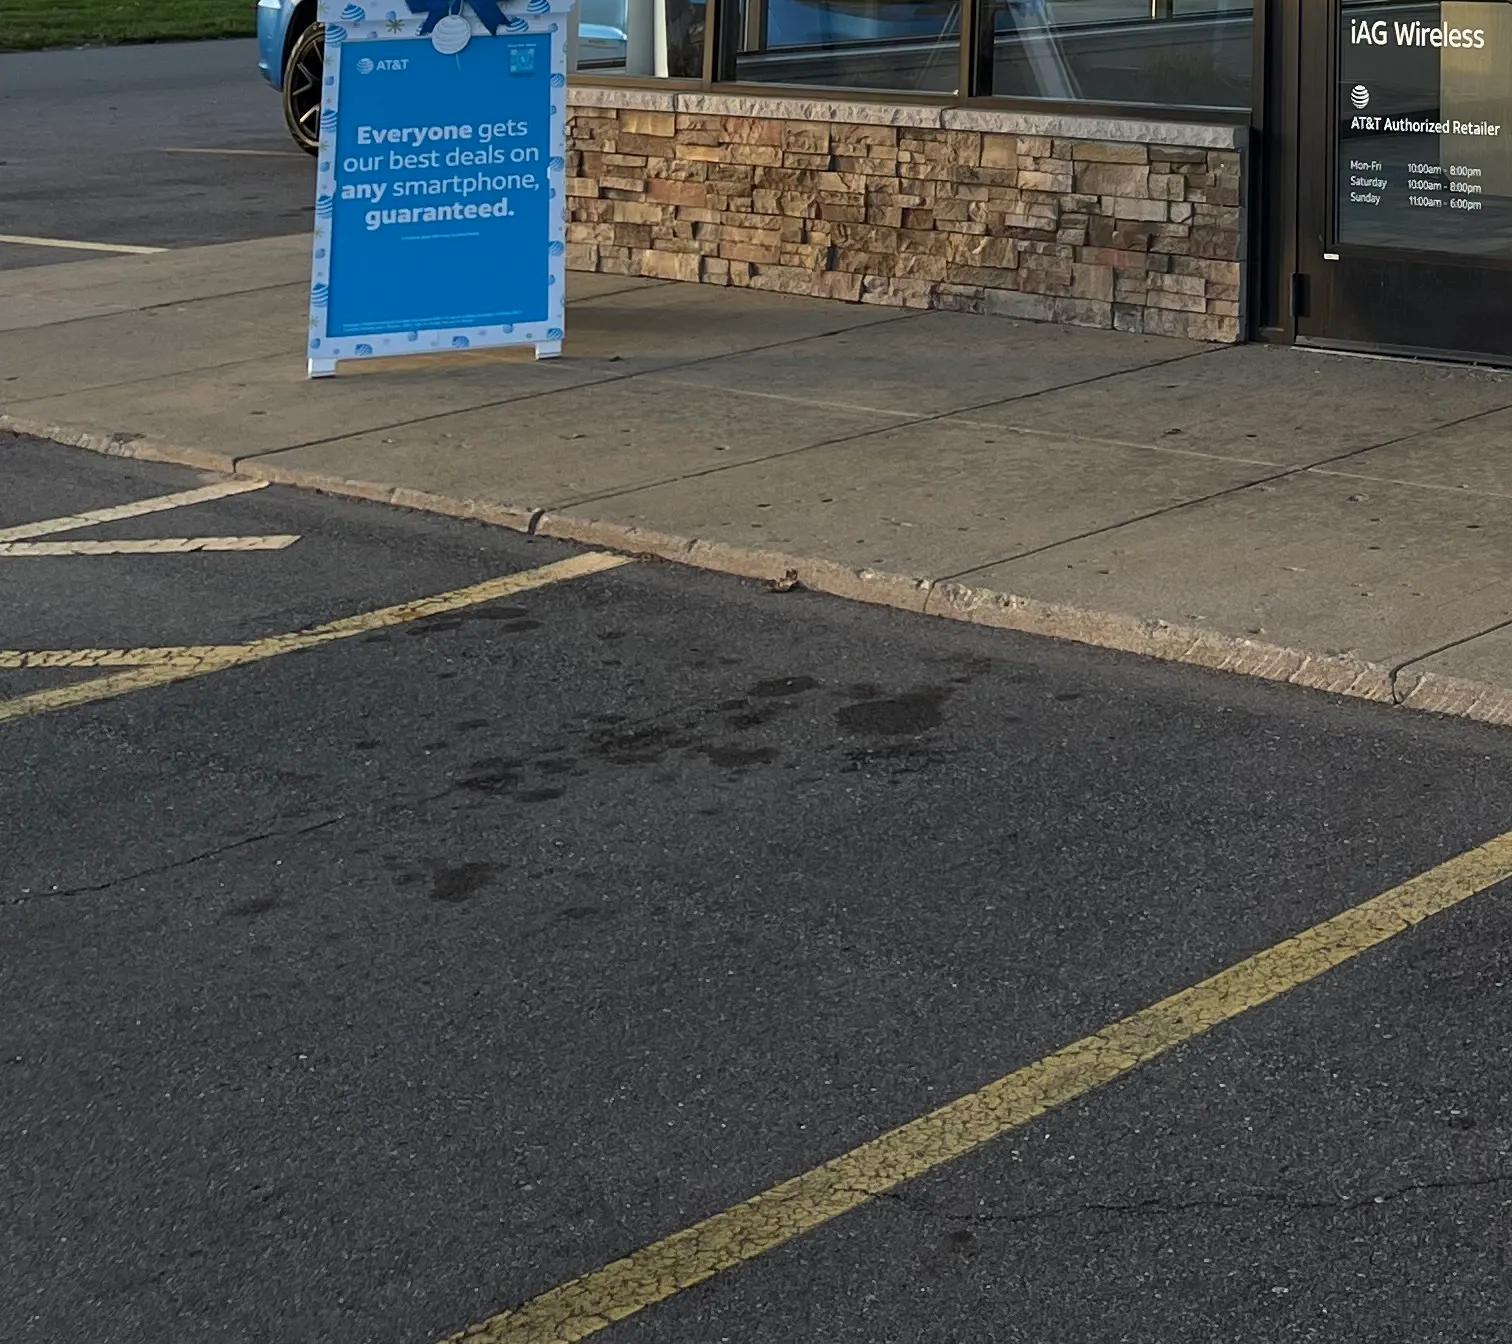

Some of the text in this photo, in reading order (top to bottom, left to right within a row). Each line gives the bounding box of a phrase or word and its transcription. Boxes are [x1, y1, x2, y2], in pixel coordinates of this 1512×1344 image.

[1351, 18, 1485, 49] iAG Wireless
[375, 59, 409, 71] AT&T
[357, 119, 528, 147] Everyone gets
[1350, 116, 1501, 136] AT&T Authorized Retailer
[343, 145, 539, 172] our best deals on
[1350, 160, 1382, 171] Mon-Fri
[1407, 163, 1442, 175] 10:00am
[1450, 165, 1482, 178] 8:00pm
[341, 172, 540, 203] any smartphone,
[1350, 176, 1388, 190] Saturday
[1407, 179, 1442, 191] 10:00am
[1450, 182, 1482, 194] 8:00pm
[1350, 191, 1381, 206] Sunday
[1408, 195, 1442, 208] 11:00am
[1450, 198, 1482, 211] 6:00pm
[365, 197, 515, 230] guaranteed.
